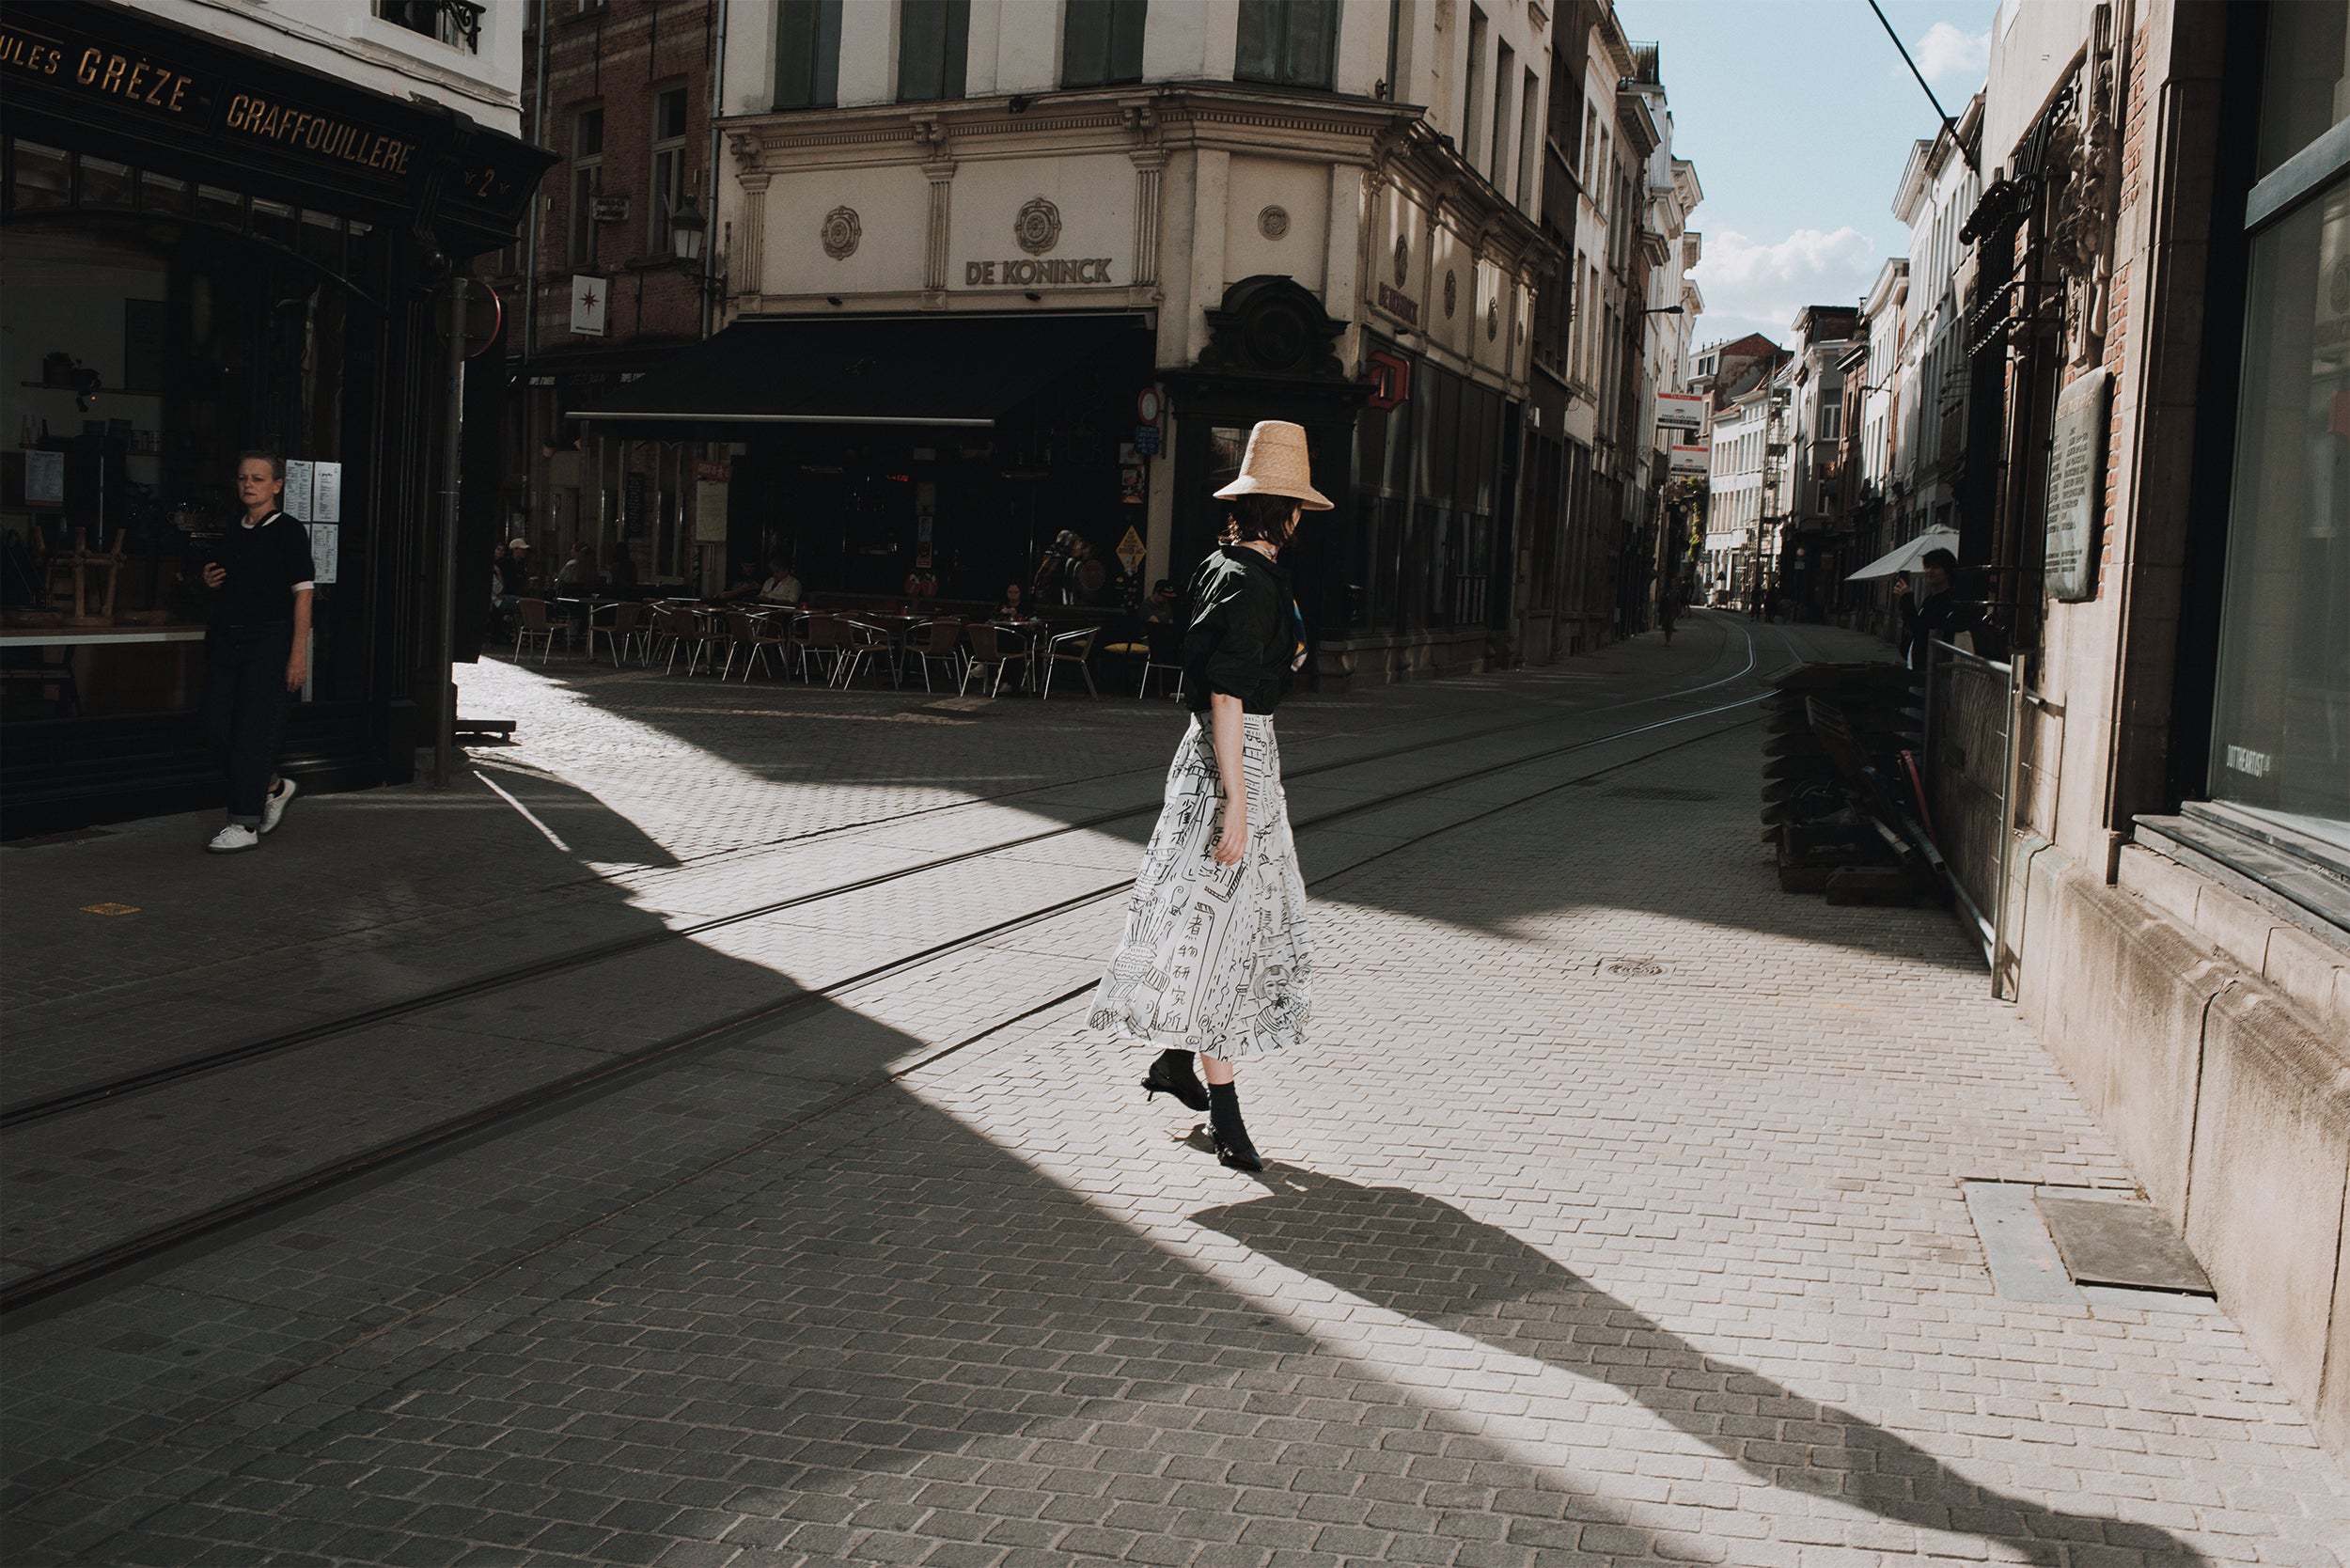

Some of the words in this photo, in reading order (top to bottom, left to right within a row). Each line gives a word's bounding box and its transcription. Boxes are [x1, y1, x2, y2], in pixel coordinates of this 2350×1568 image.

[75, 46, 194, 113] GRÈZE
[225, 92, 416, 176] GRAFFOUILLERE
[476, 167, 495, 198] 2
[965, 260, 995, 285] DE
[1001, 258, 1113, 285] KONINCK
